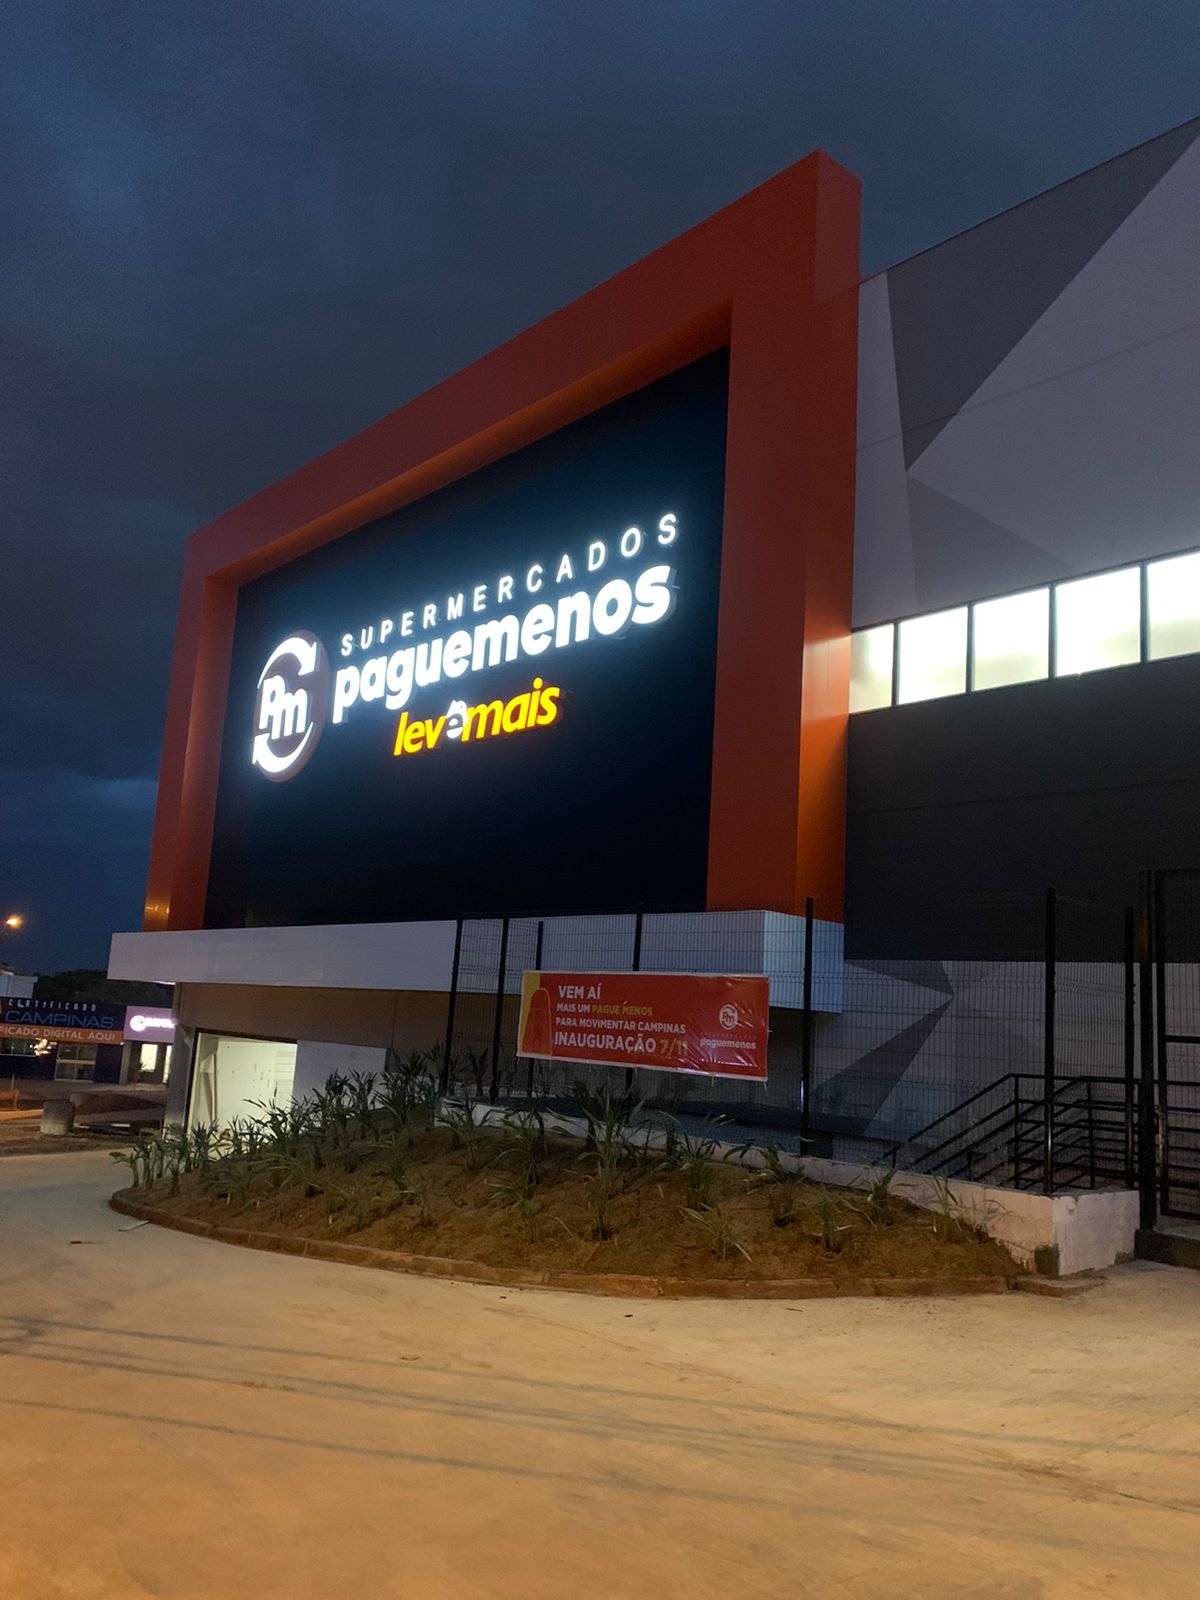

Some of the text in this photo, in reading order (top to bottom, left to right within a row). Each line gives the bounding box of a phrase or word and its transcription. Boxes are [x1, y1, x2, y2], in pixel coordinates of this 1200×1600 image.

[341, 513, 677, 656] SUPERMERCADOS
[332, 565, 672, 724] paguemenos
[558, 982, 602, 1000] VEM AÍ
[556, 1003, 654, 1016] MAIS UM PAGUE MENOS
[5, 1010, 114, 1029] CAMPINAS
[555, 1017, 687, 1034] PARA MOVIMENTAR CAMPINAS
[43, 1028, 83, 1039] DIGITAL
[88, 1031, 115, 1041] AQUI
[554, 1031, 657, 1054] INAUGURAÇÃO
